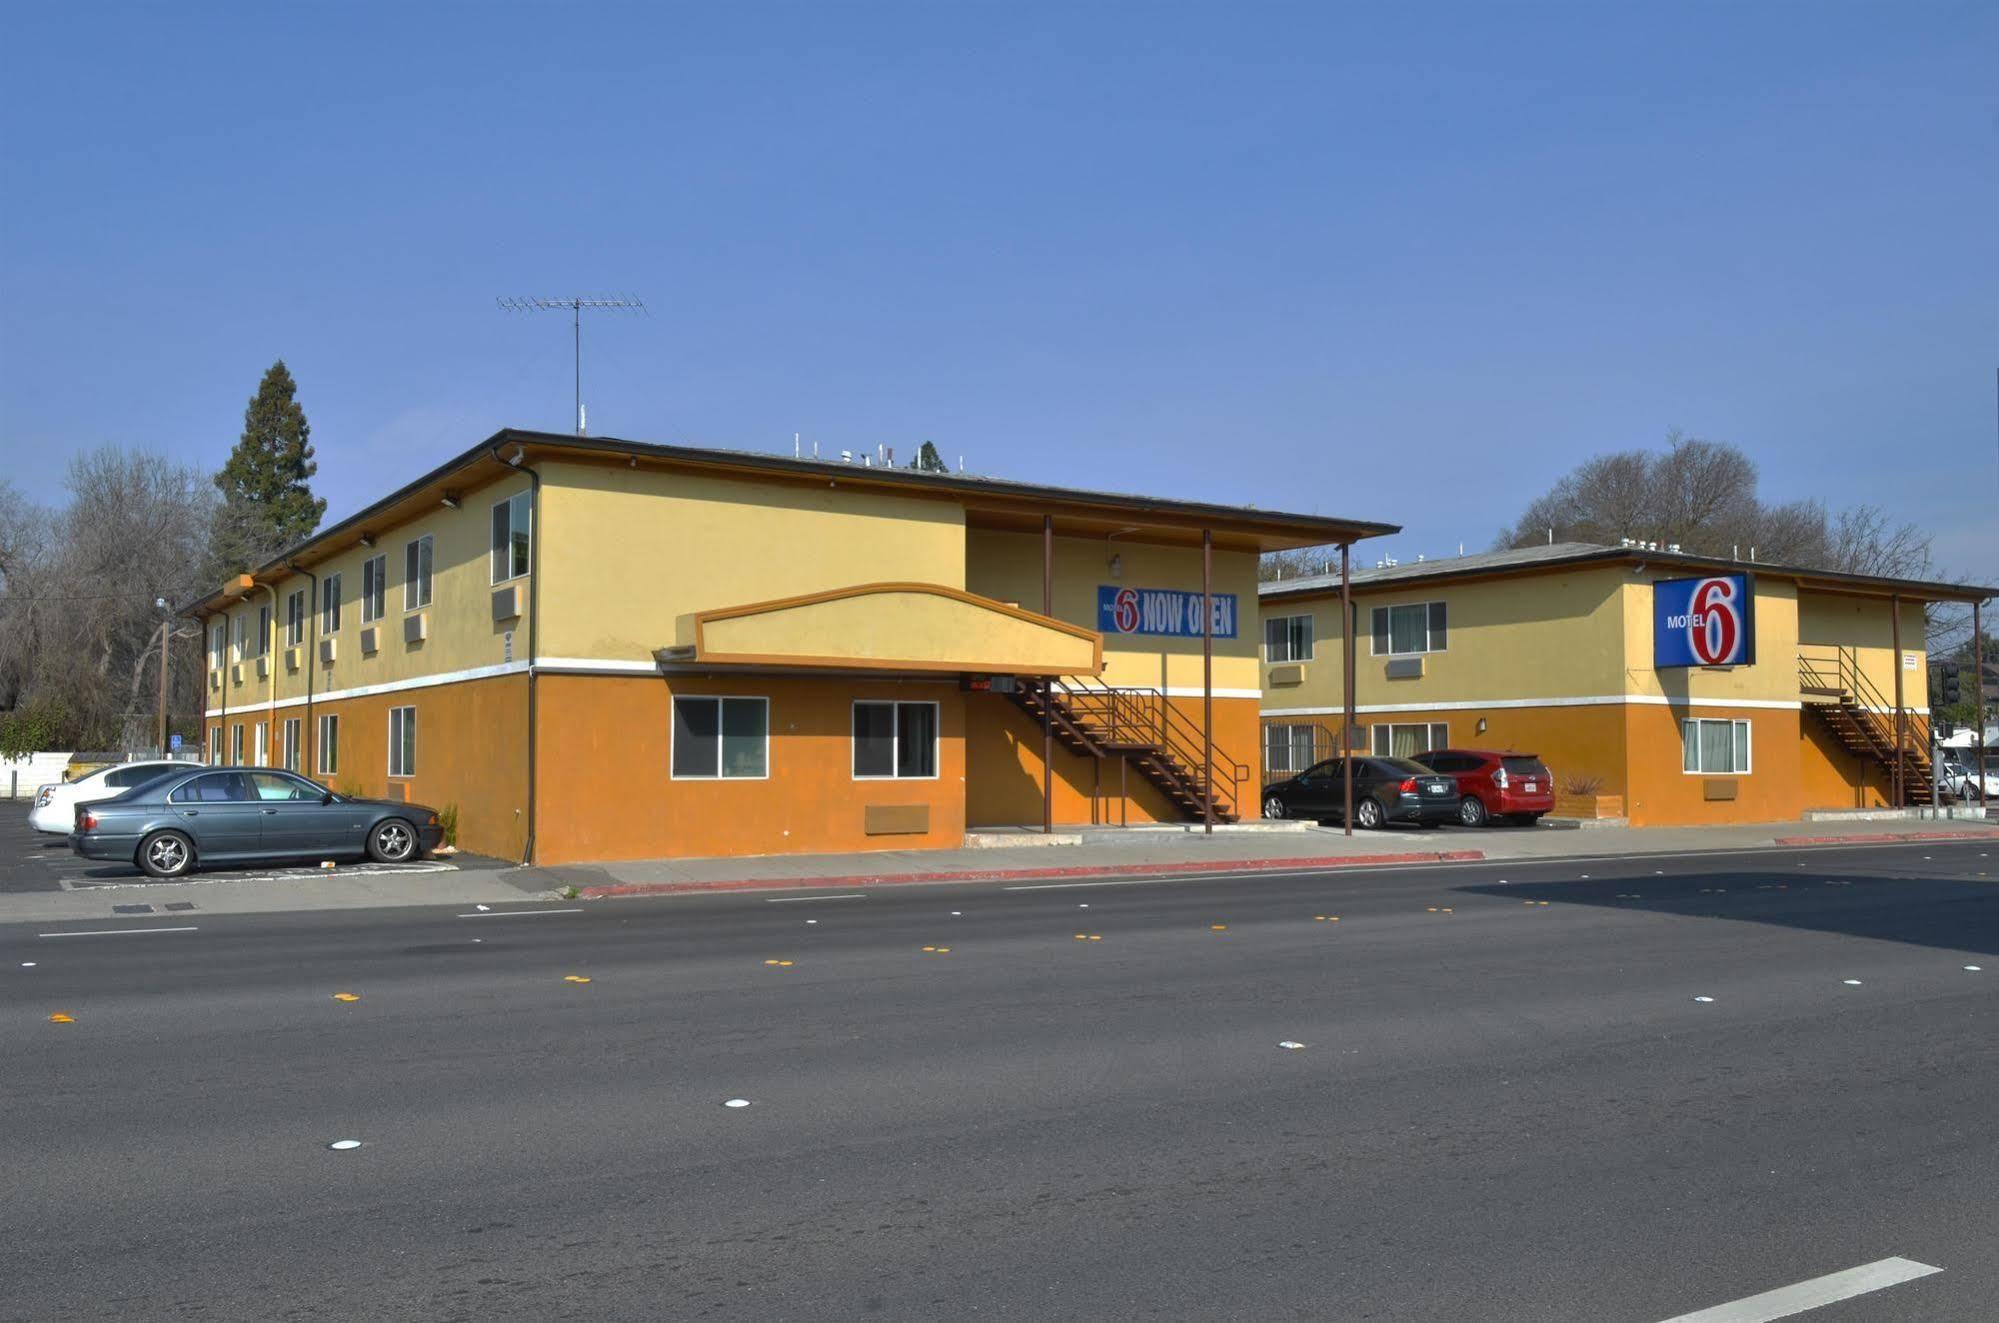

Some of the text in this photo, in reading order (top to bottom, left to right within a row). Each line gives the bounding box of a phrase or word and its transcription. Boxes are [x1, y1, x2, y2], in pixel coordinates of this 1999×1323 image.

[1115, 588, 1139, 633] 6
[1143, 592, 1183, 633] NOW
[1667, 578, 1739, 664] MOTEL 6
